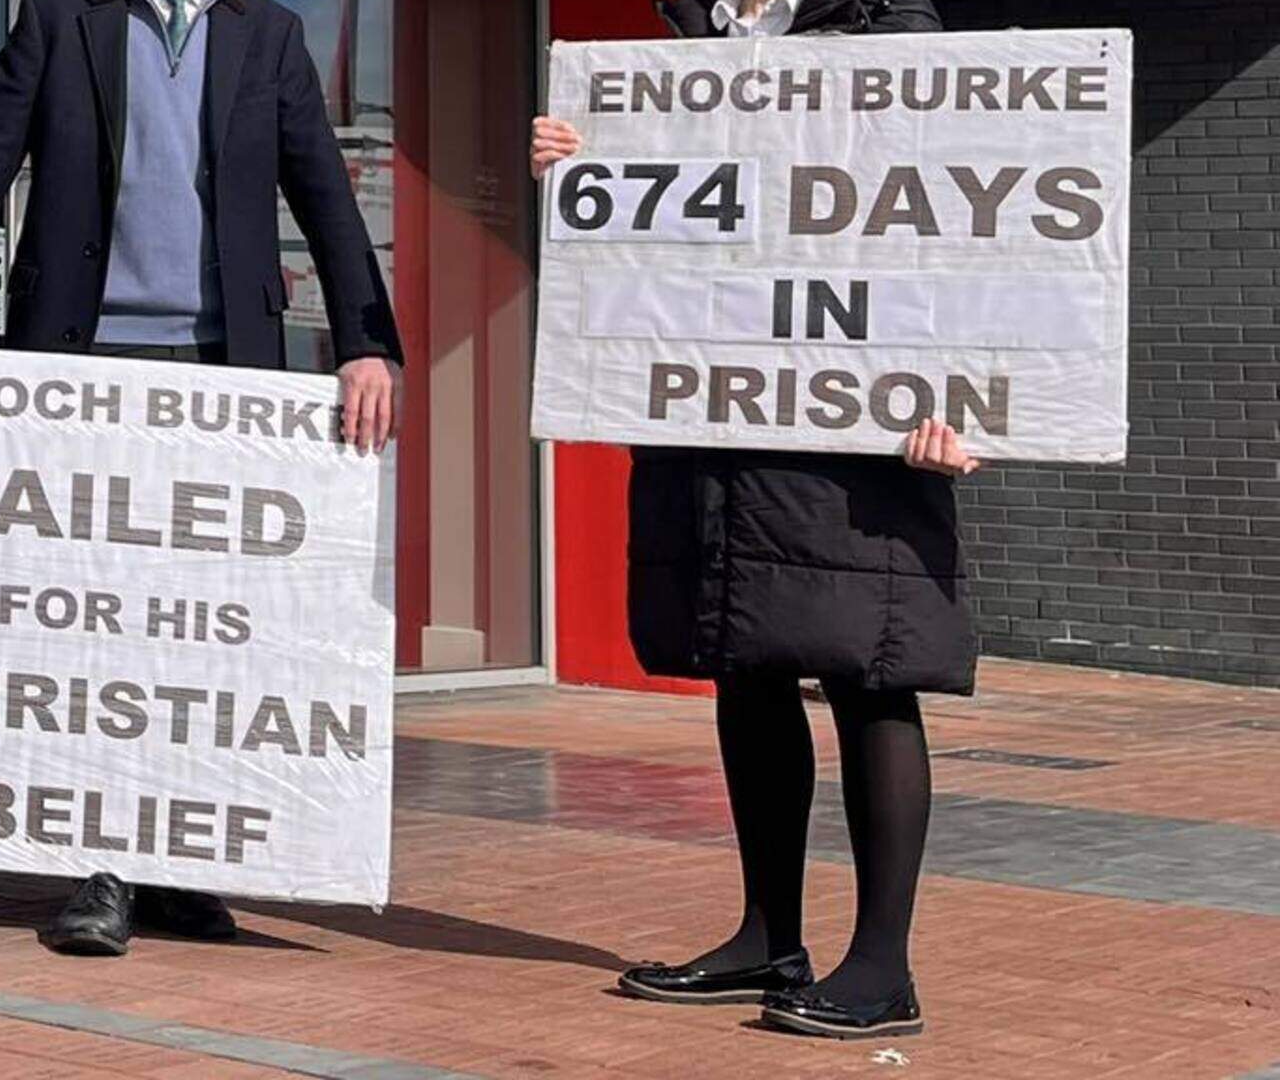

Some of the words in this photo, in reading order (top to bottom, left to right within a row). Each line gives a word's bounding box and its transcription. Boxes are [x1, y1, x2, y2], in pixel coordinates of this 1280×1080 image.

[589, 68, 822, 114] ENOCH
[851, 66, 1109, 113] BURKE
[557, 162, 744, 233] 674
[788, 165, 1105, 242] DAYS
[771, 279, 869, 341] IN
[648, 362, 1011, 436] PRISON
[146, 596, 252, 645] HIS
